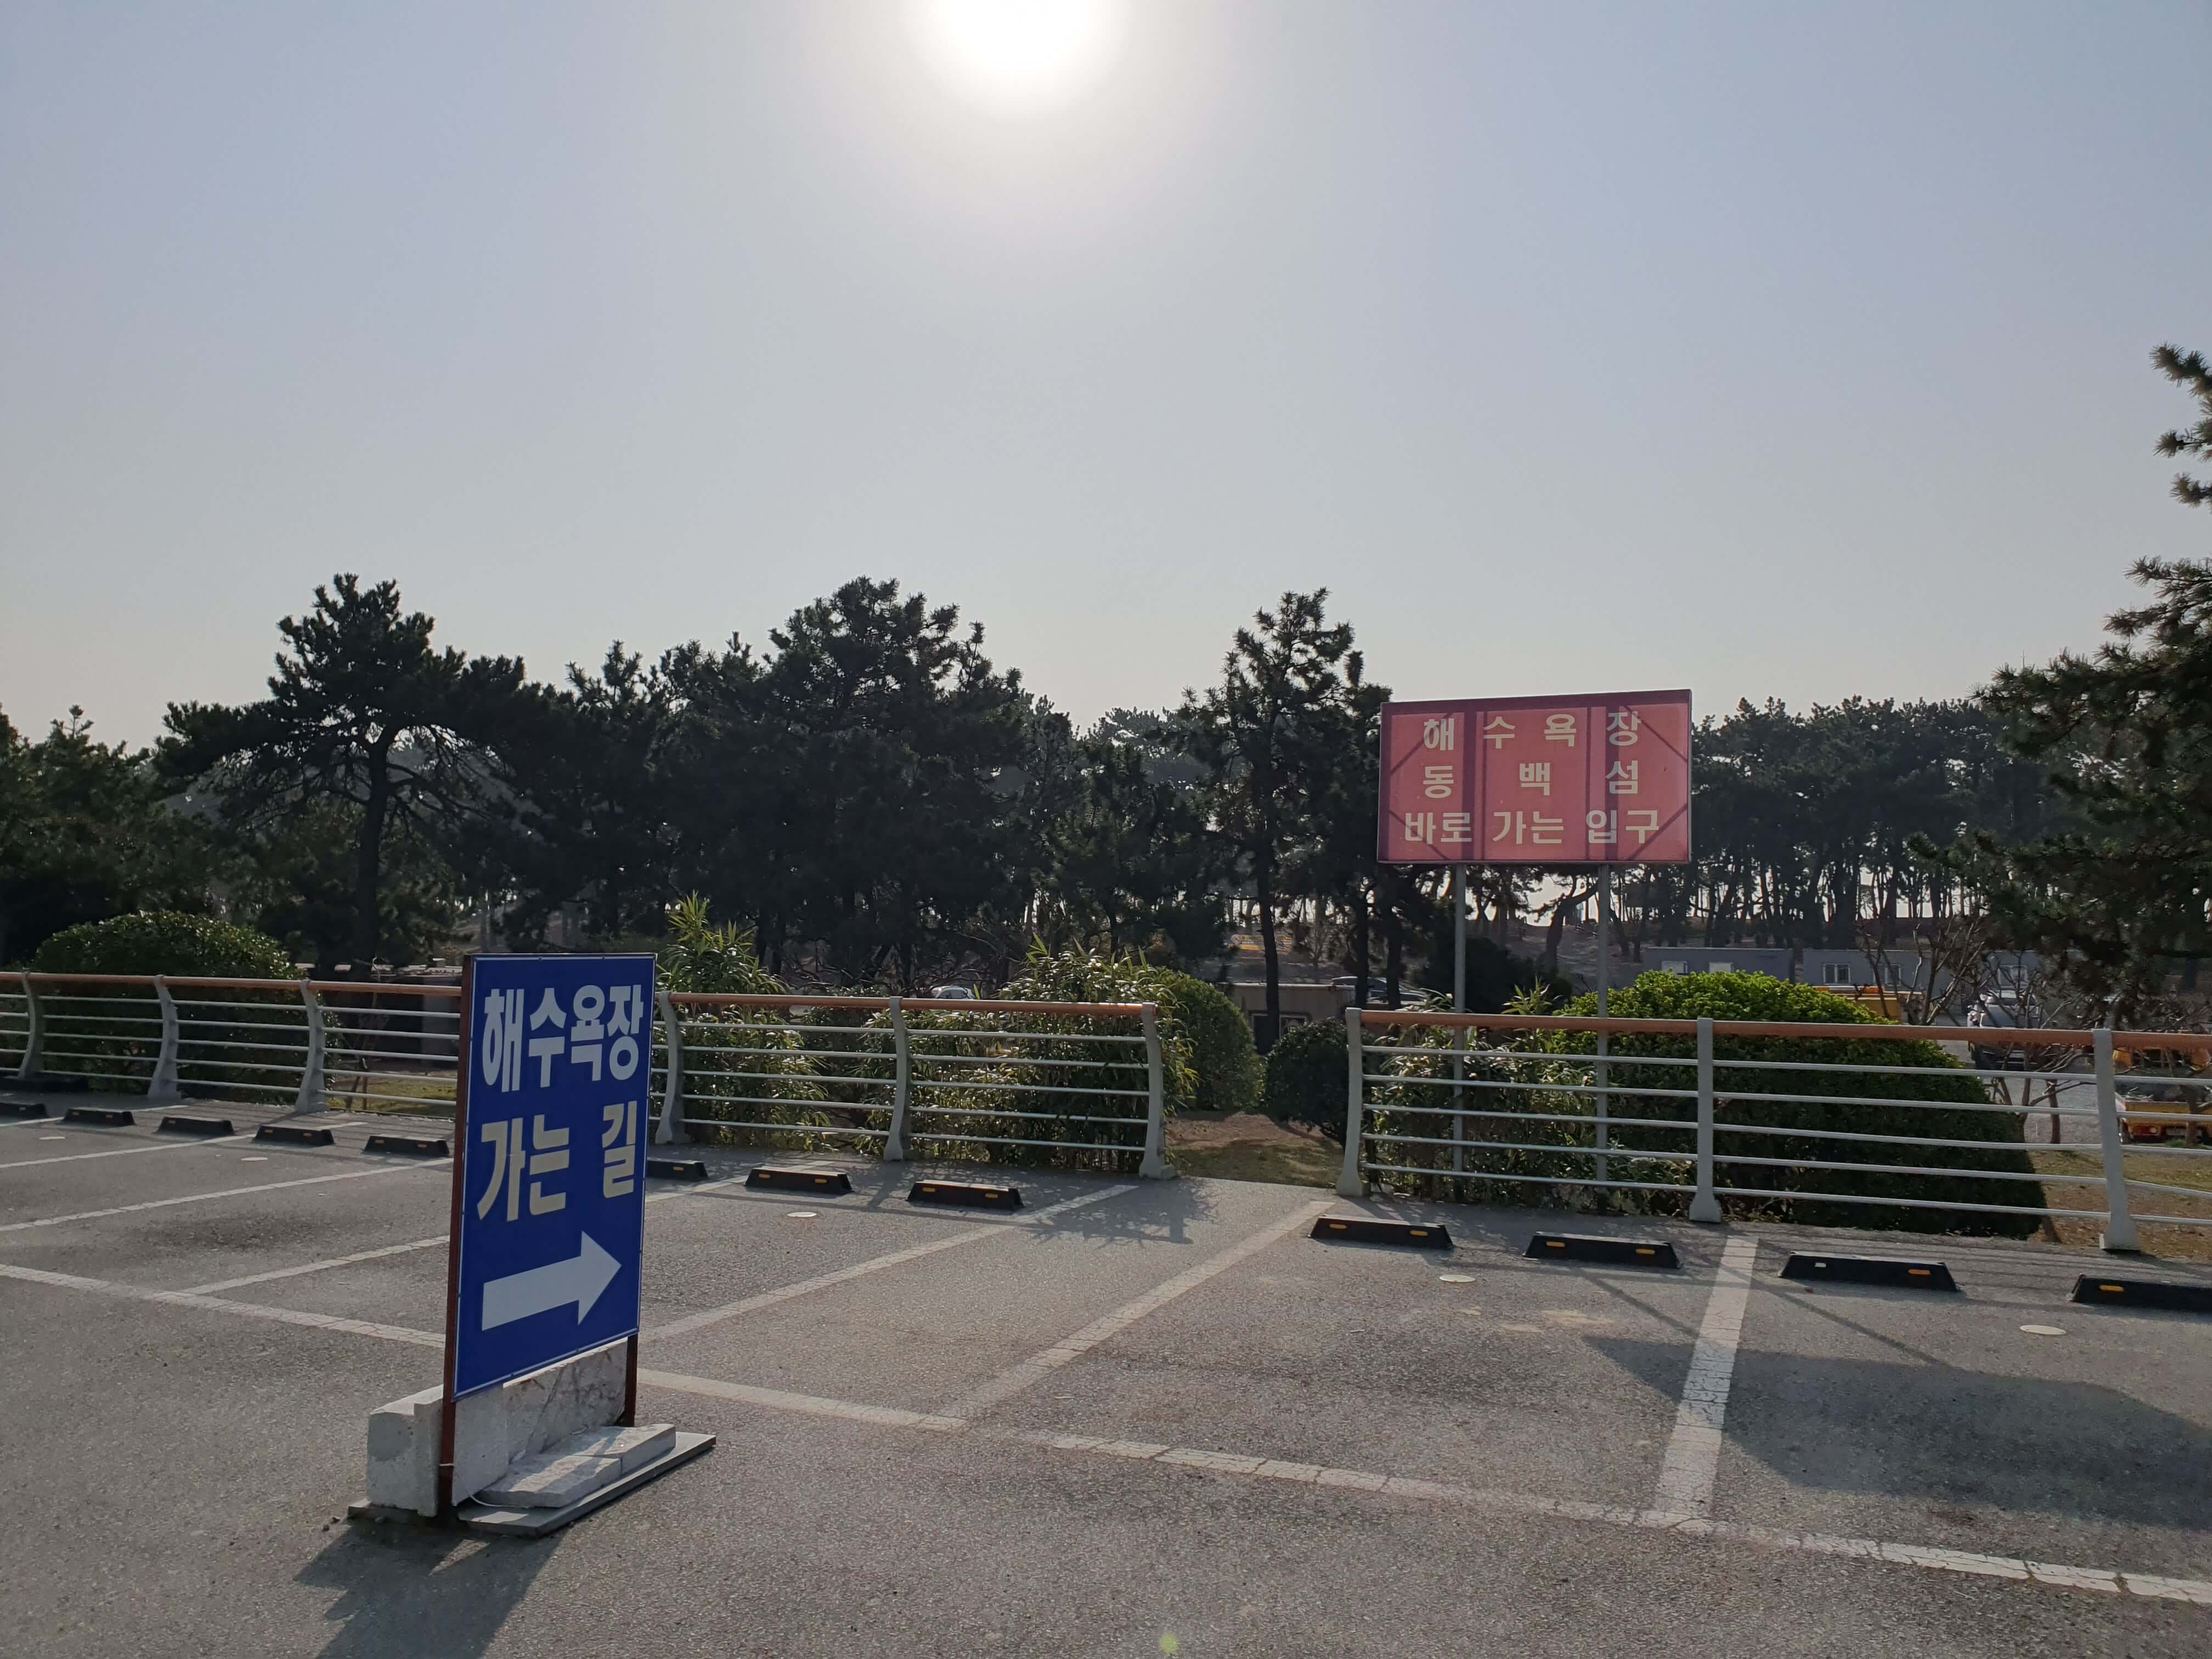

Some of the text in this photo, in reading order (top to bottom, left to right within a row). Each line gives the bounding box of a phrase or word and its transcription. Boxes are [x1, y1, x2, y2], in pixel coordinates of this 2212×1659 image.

[1404, 809, 1660, 845] 바로 가는 입구
[482, 984, 644, 1093] 해수욕장
[477, 1100, 637, 1222] 가는 길
